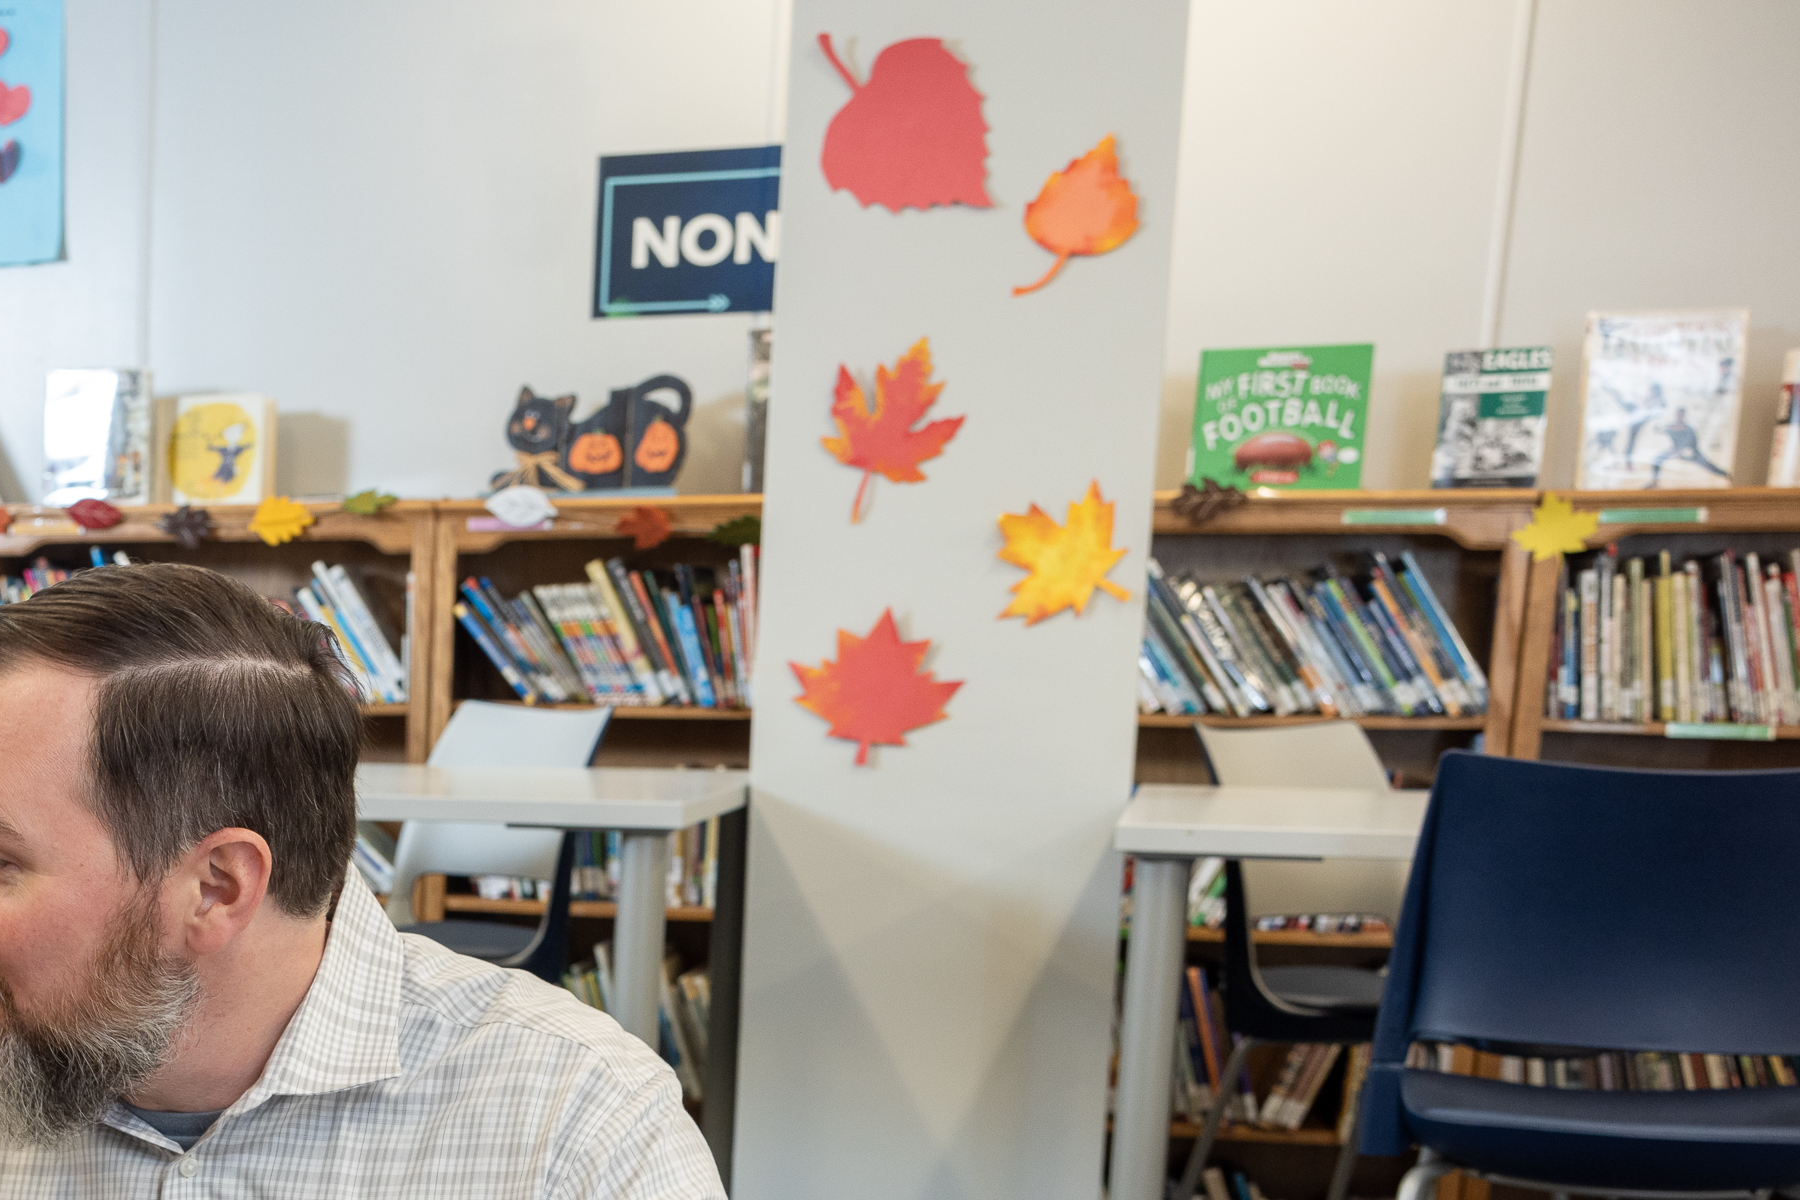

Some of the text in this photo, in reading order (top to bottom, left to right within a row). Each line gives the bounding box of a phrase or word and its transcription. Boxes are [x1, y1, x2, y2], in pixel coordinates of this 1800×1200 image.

[631, 210, 781, 269] NON
[1482, 350, 1553, 371] EAGLES
[1237, 370, 1310, 400] FIRST
[1310, 374, 1362, 400] BOOK
[1202, 397, 1356, 452] FOOTBALL
